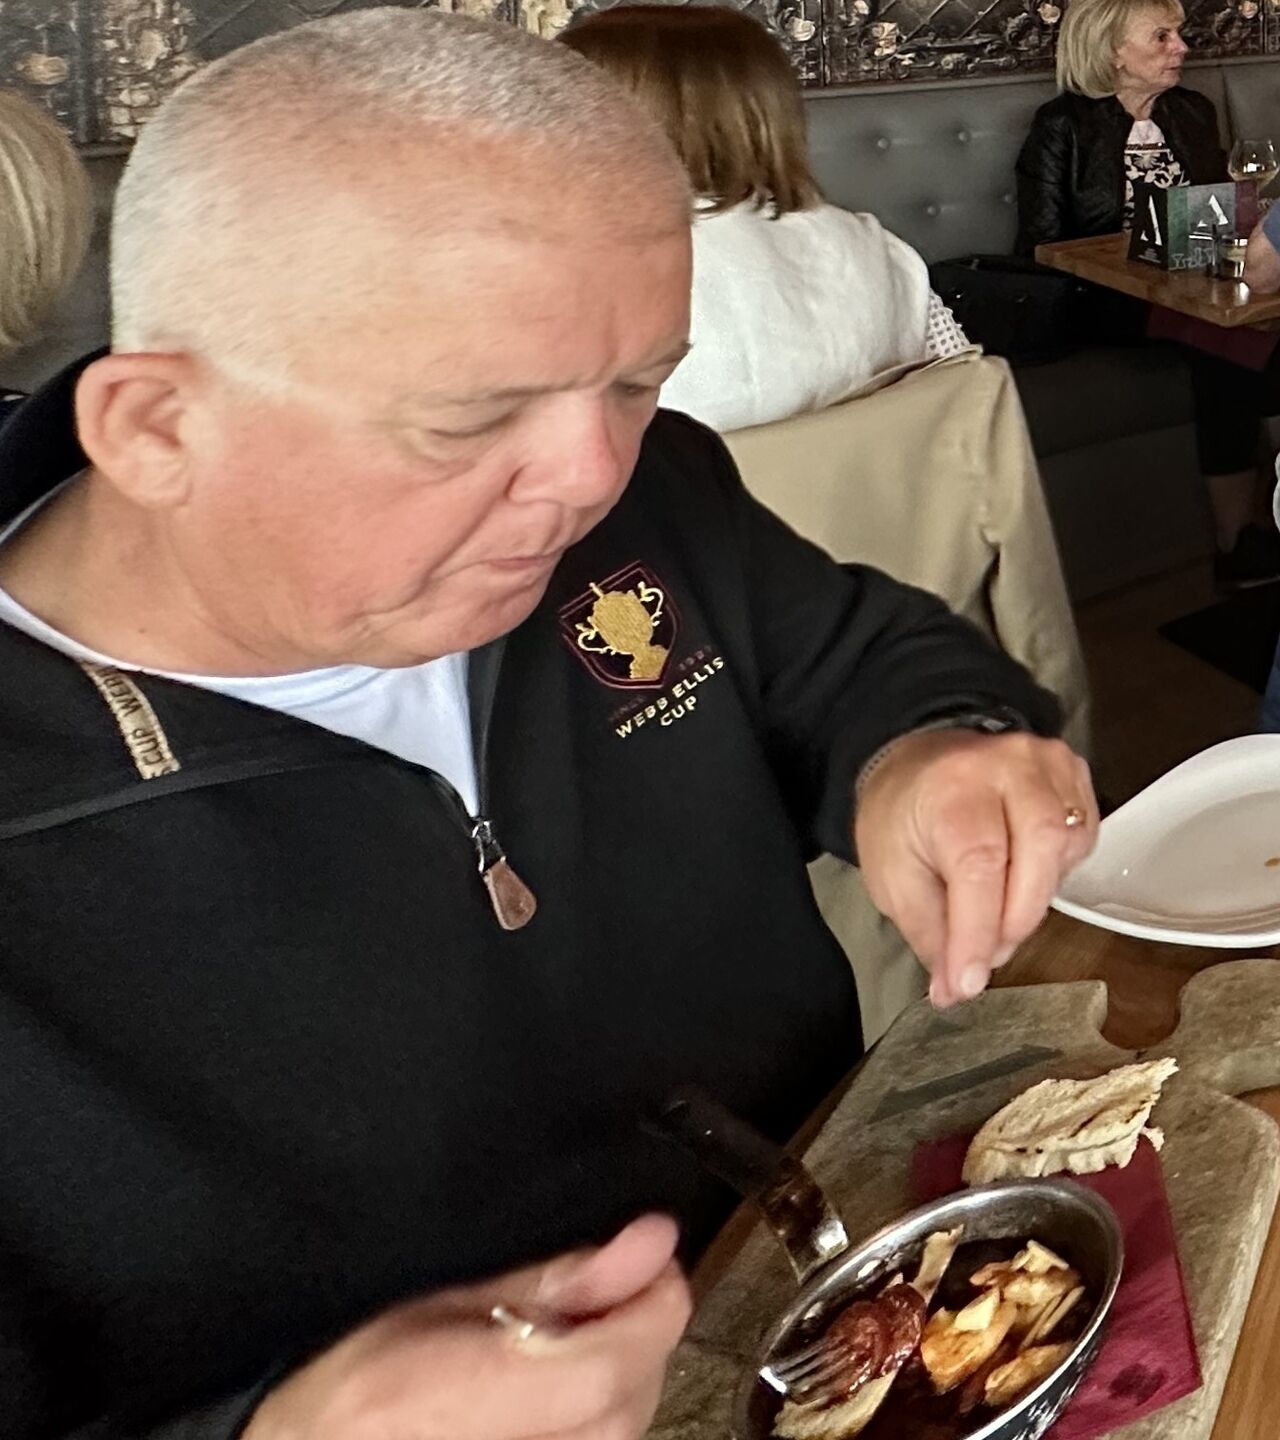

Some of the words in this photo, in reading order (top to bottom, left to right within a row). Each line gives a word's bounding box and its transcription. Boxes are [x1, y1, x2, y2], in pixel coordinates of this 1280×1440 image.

[615, 696, 669, 738] WEBB
[671, 656, 724, 698] ELLIS
[660, 695, 697, 727] CUP
[132, 729, 165, 766] CUP
